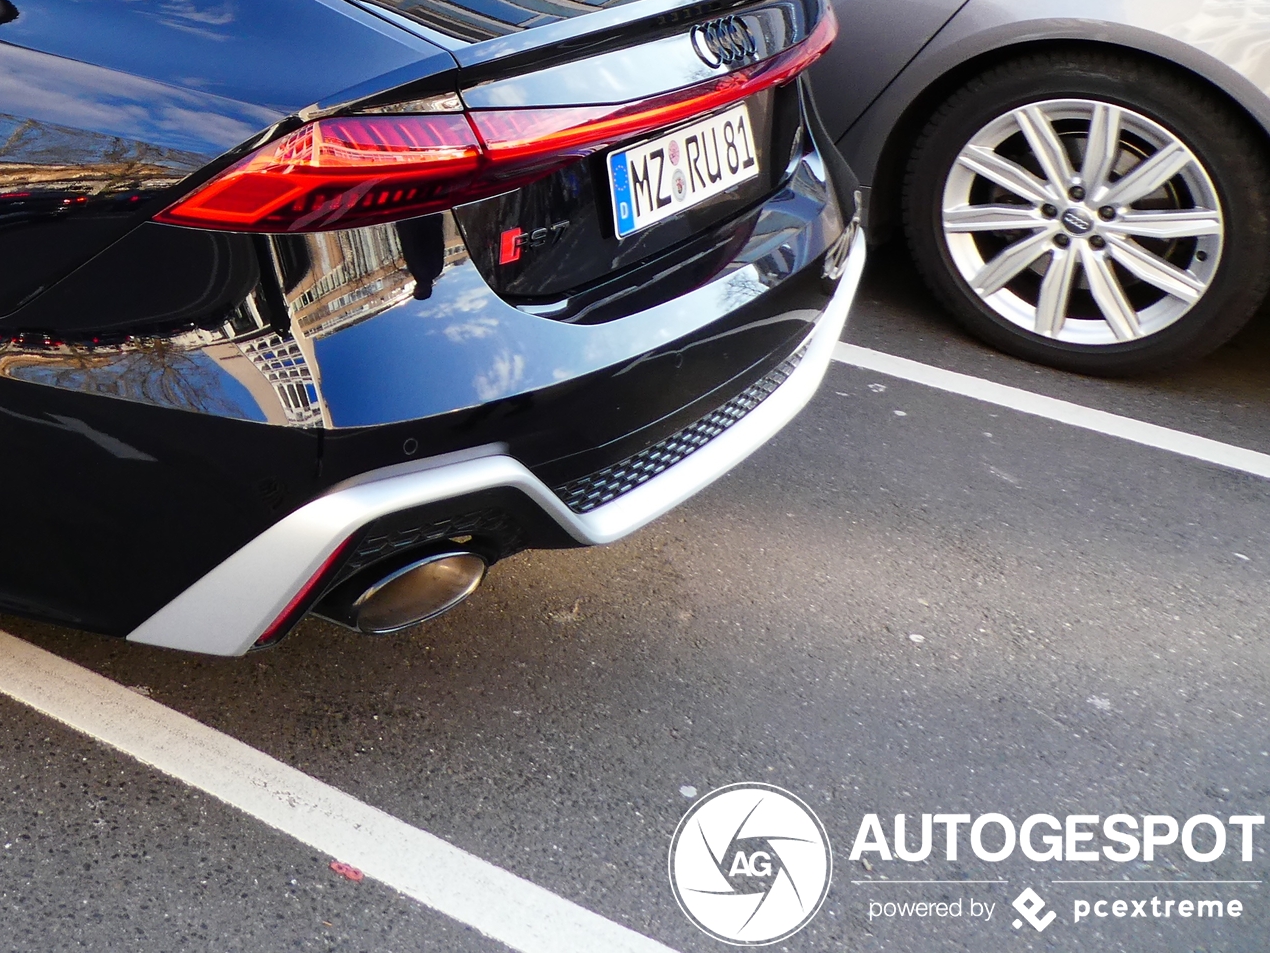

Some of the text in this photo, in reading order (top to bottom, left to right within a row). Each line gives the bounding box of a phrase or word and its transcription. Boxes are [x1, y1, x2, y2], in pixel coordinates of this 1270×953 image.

[619, 114, 755, 220] D MZ RU 81
[511, 220, 570, 257] RS7
